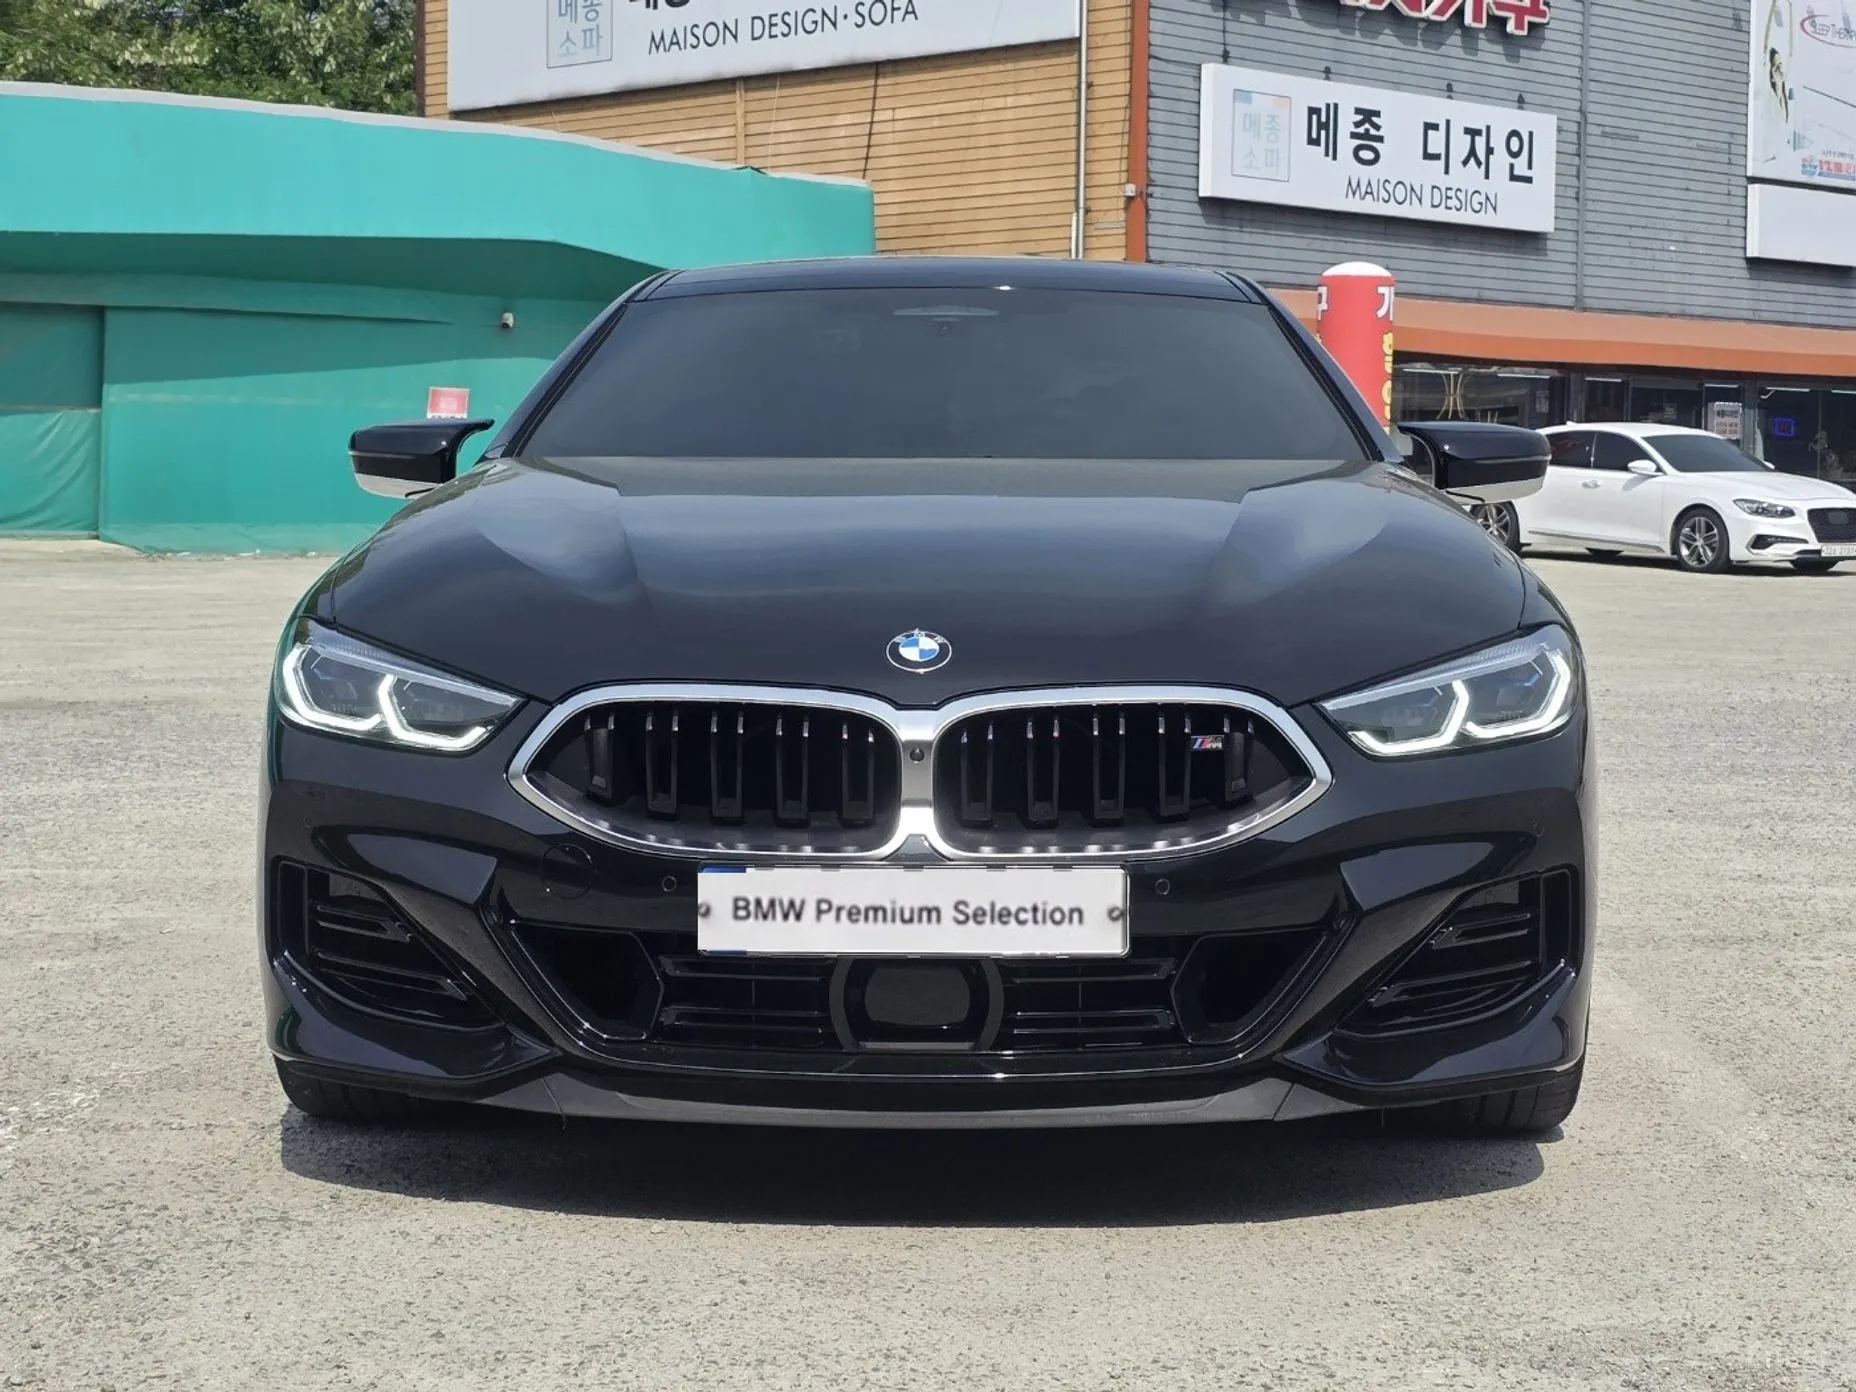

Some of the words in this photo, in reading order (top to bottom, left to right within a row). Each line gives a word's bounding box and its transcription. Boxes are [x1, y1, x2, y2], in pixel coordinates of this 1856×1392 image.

[558, 24, 602, 58] 소파
[649, 18, 738, 56] MAISON
[1242, 108, 1281, 144] 메종
[1306, 102, 1385, 167] 메종
[1422, 118, 1534, 185] 디자인
[1242, 147, 1281, 175] 소파
[1346, 175, 1424, 208] MAISON
[1430, 184, 1498, 215] DESIGN
[732, 896, 806, 922] BMW
[816, 898, 942, 925] Premium
[952, 900, 1084, 927] Selection
